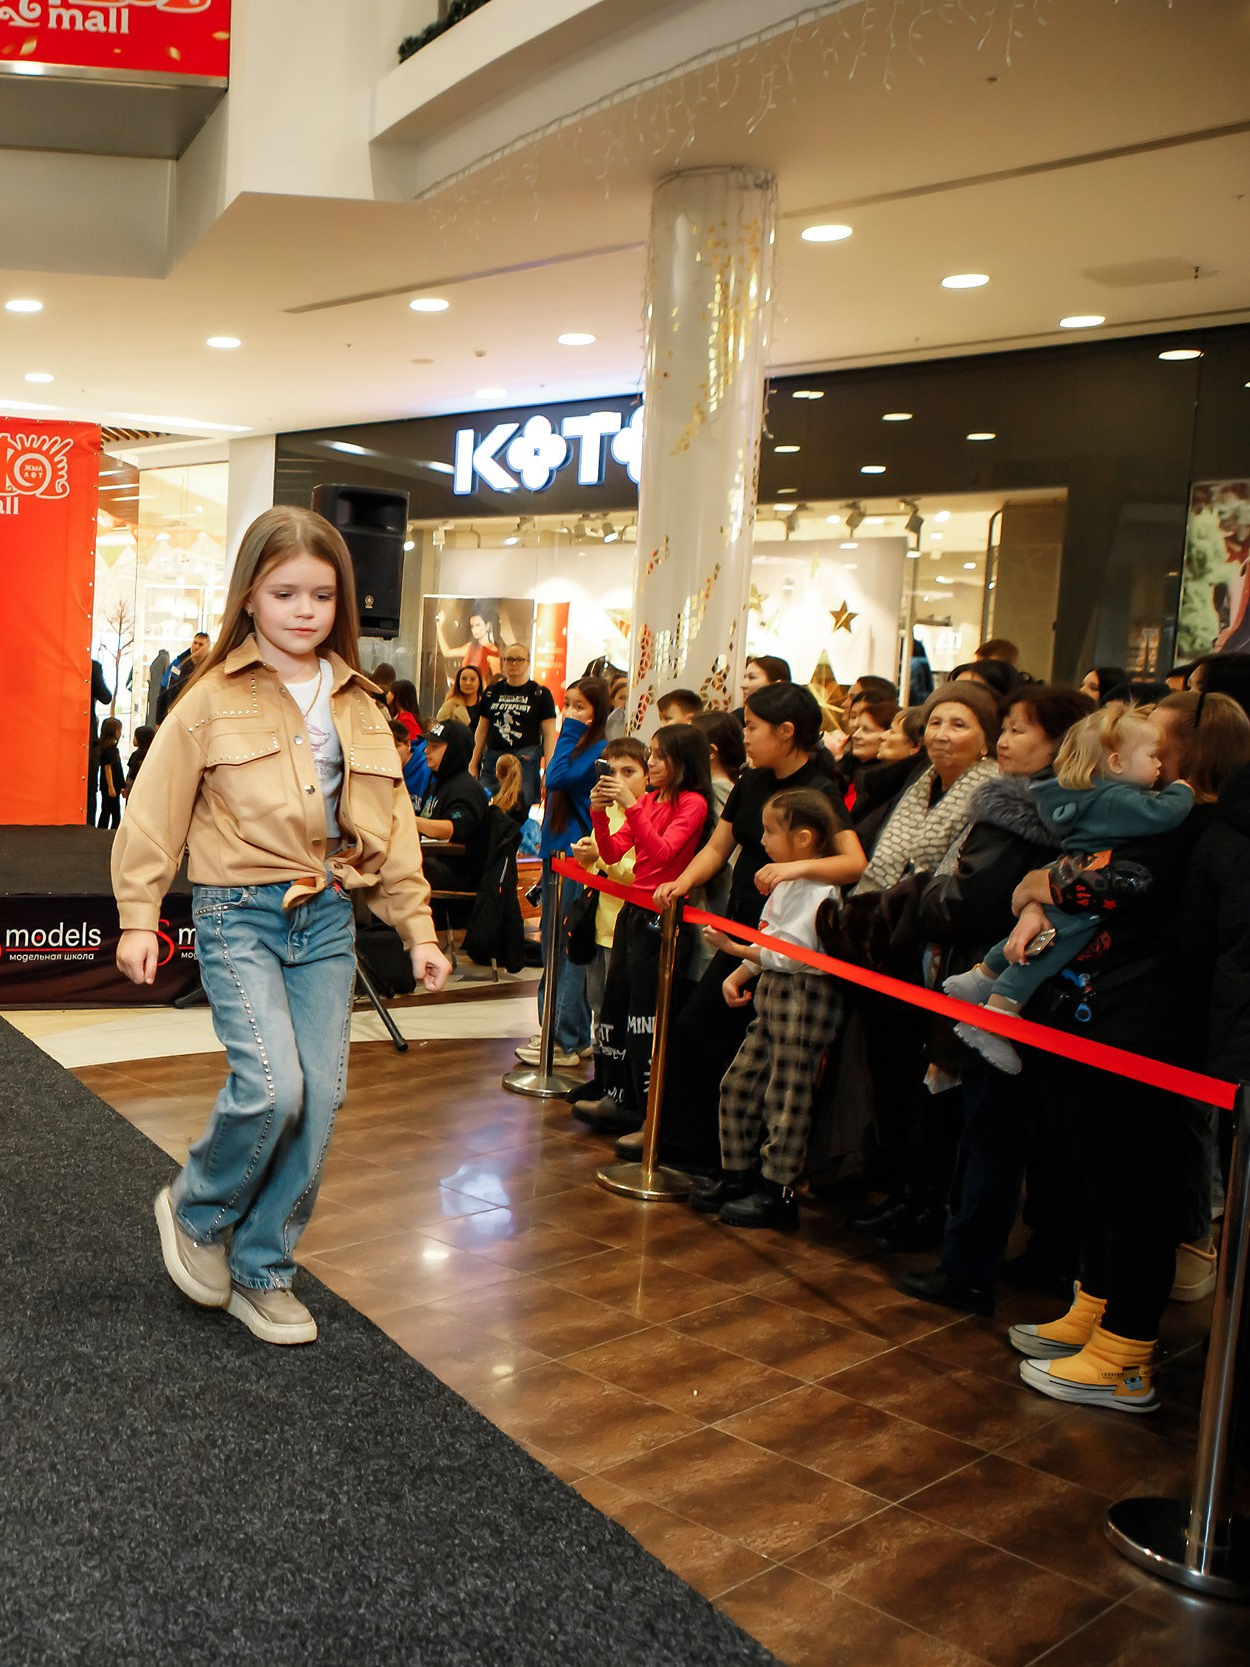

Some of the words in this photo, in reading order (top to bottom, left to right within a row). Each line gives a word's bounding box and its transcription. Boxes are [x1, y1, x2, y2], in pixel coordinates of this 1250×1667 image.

[48, 7, 129, 34] mall
[5, 922, 101, 947] models
[9, 953, 62, 962] модельная
[63, 952, 94, 961] школа
